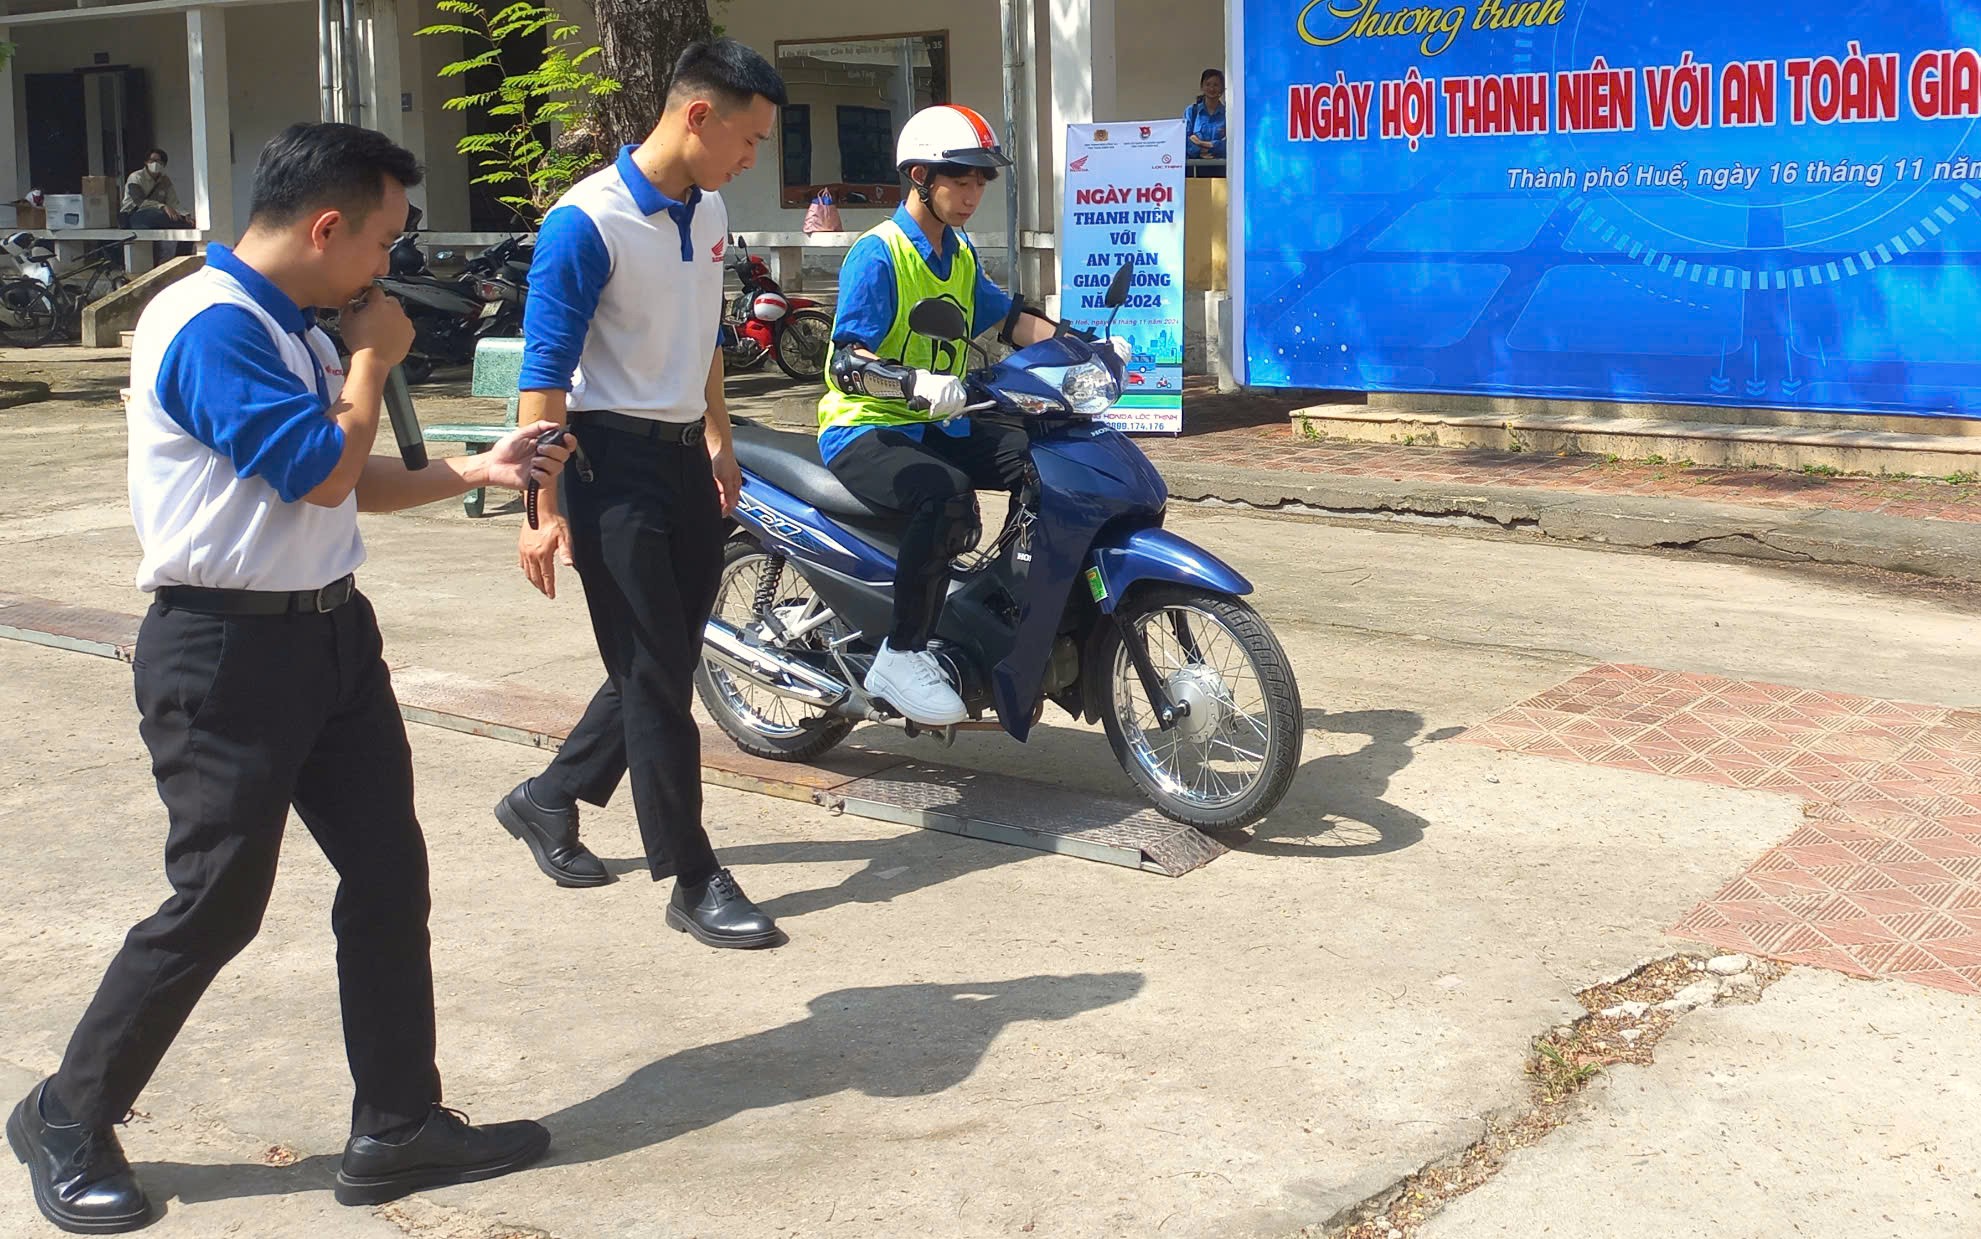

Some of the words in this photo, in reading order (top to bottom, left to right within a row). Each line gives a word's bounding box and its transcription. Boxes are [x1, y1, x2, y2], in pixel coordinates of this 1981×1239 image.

[1288, 71, 1374, 141] NGÀY
[1381, 67, 1435, 151] HỘI
[1443, 73, 1548, 136] THANH
[1557, 57, 1635, 133] NIÊN
[1644, 51, 1712, 130] VỚI
[1721, 60, 1776, 127] AN
[1785, 41, 1899, 124] TOÀN
[1908, 49, 1981, 119] GIA
[1507, 167, 1576, 188] Thành
[1583, 161, 1633, 192] phố
[1635, 160, 1689, 189] Huế,
[1697, 162, 1760, 191] ngày
[1771, 161, 1799, 184] 16
[1806, 159, 1884, 187] tháng
[1895, 158, 1924, 182] 11
[1076, 184, 1132, 205] NGÀY
[1136, 183, 1173, 207] HỘI
[1074, 211, 1129, 225] THANH
[1133, 207, 1174, 224] NIÊN
[1110, 229, 1136, 246] VỚI
[1086, 253, 1110, 267] AN
[1114, 249, 1158, 266] TOÀN
[1073, 273, 1111, 288] GIAO
[1081, 291, 1105, 309] NĂ
[1124, 294, 1162, 308] 2024
